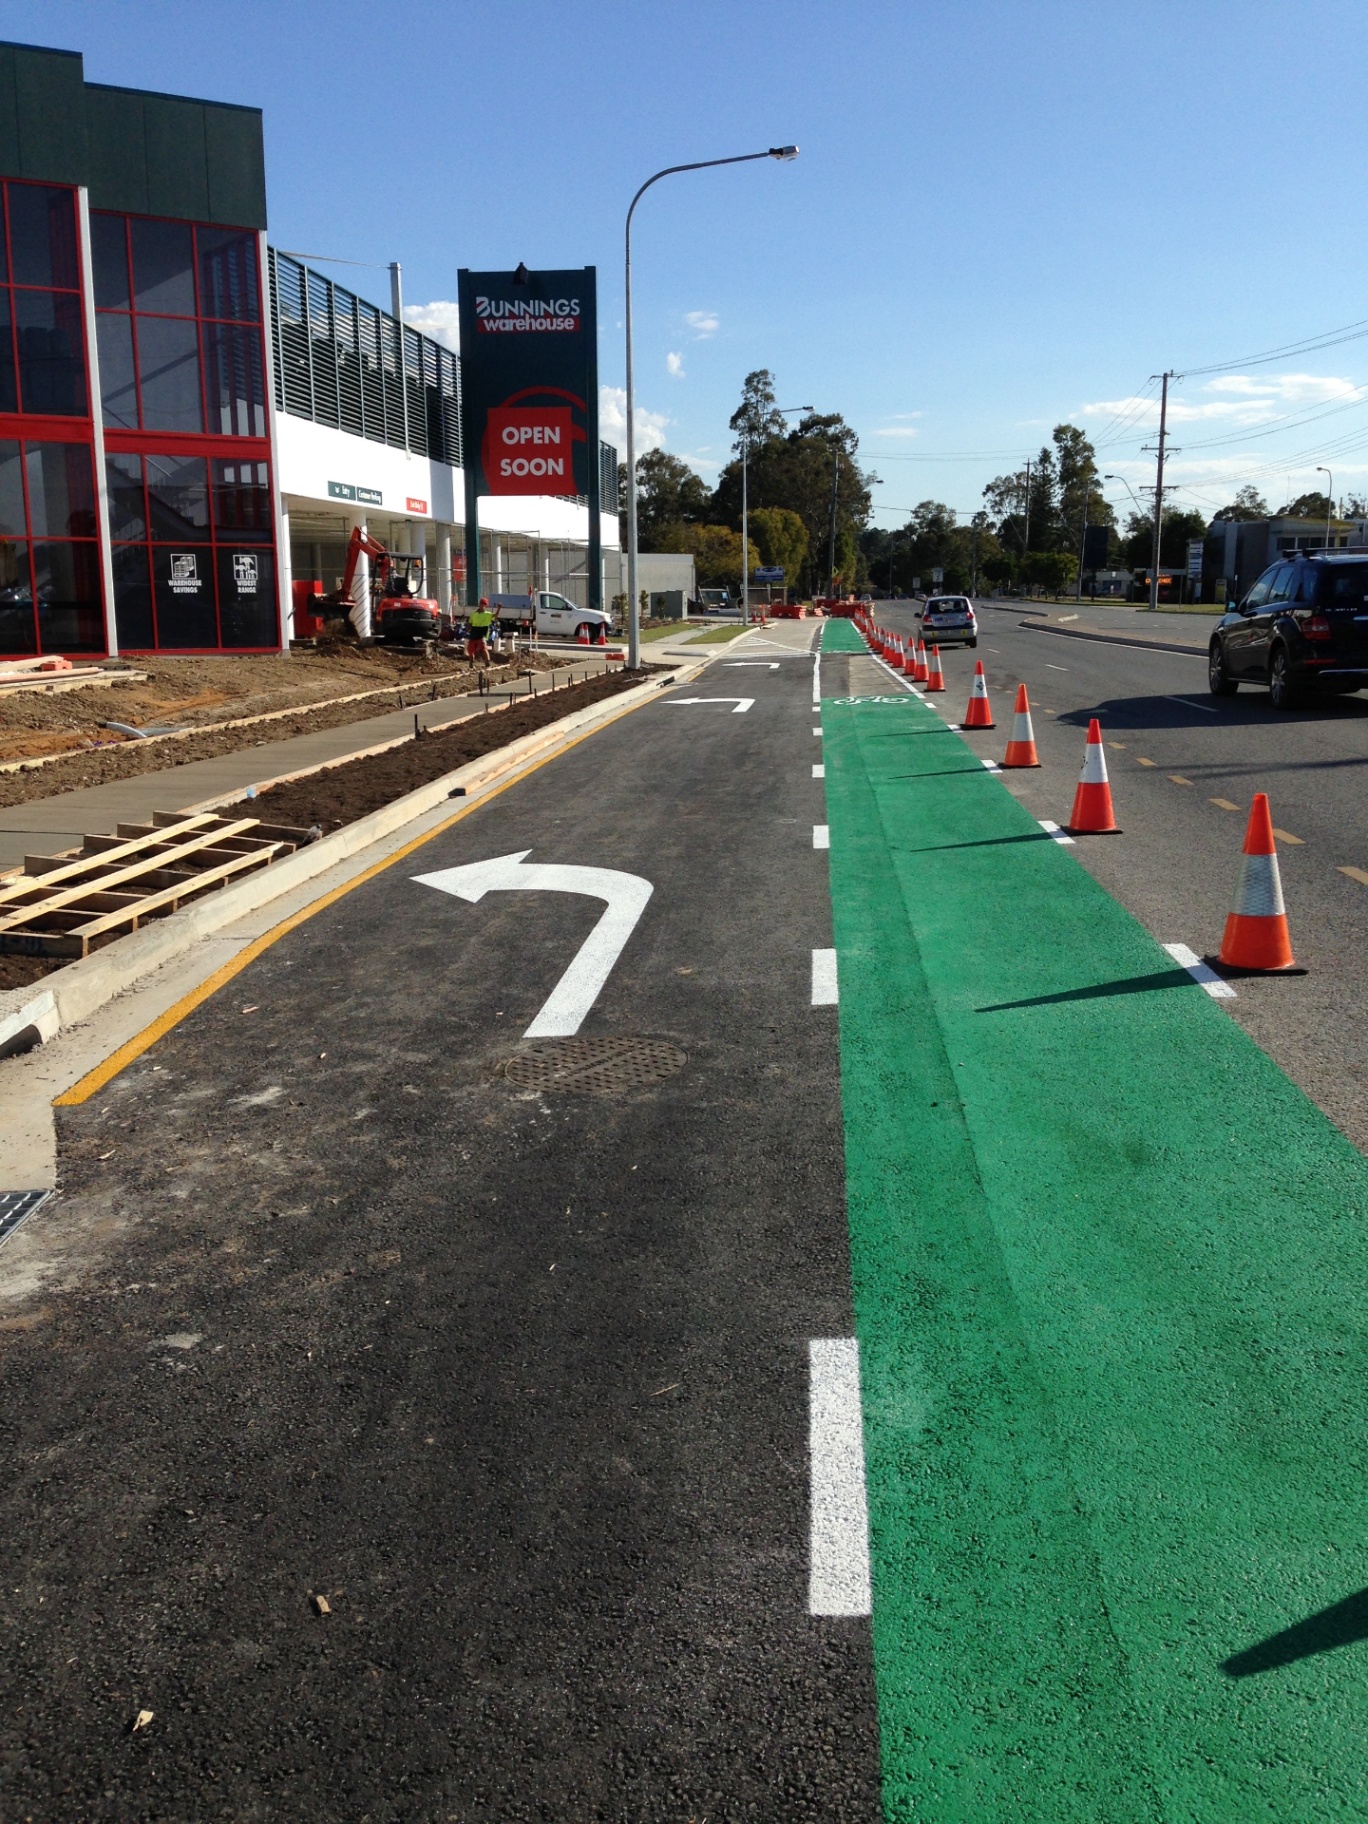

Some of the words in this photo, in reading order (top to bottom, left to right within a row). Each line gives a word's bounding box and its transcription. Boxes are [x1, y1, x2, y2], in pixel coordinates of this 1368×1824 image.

[475, 296, 580, 317] BUNNINGS
[483, 312, 575, 332] warehouse
[502, 426, 561, 444] OPEN
[500, 458, 564, 476] SOON
[173, 586, 198, 594] SAVINGS
[237, 586, 257, 594] RANGE
